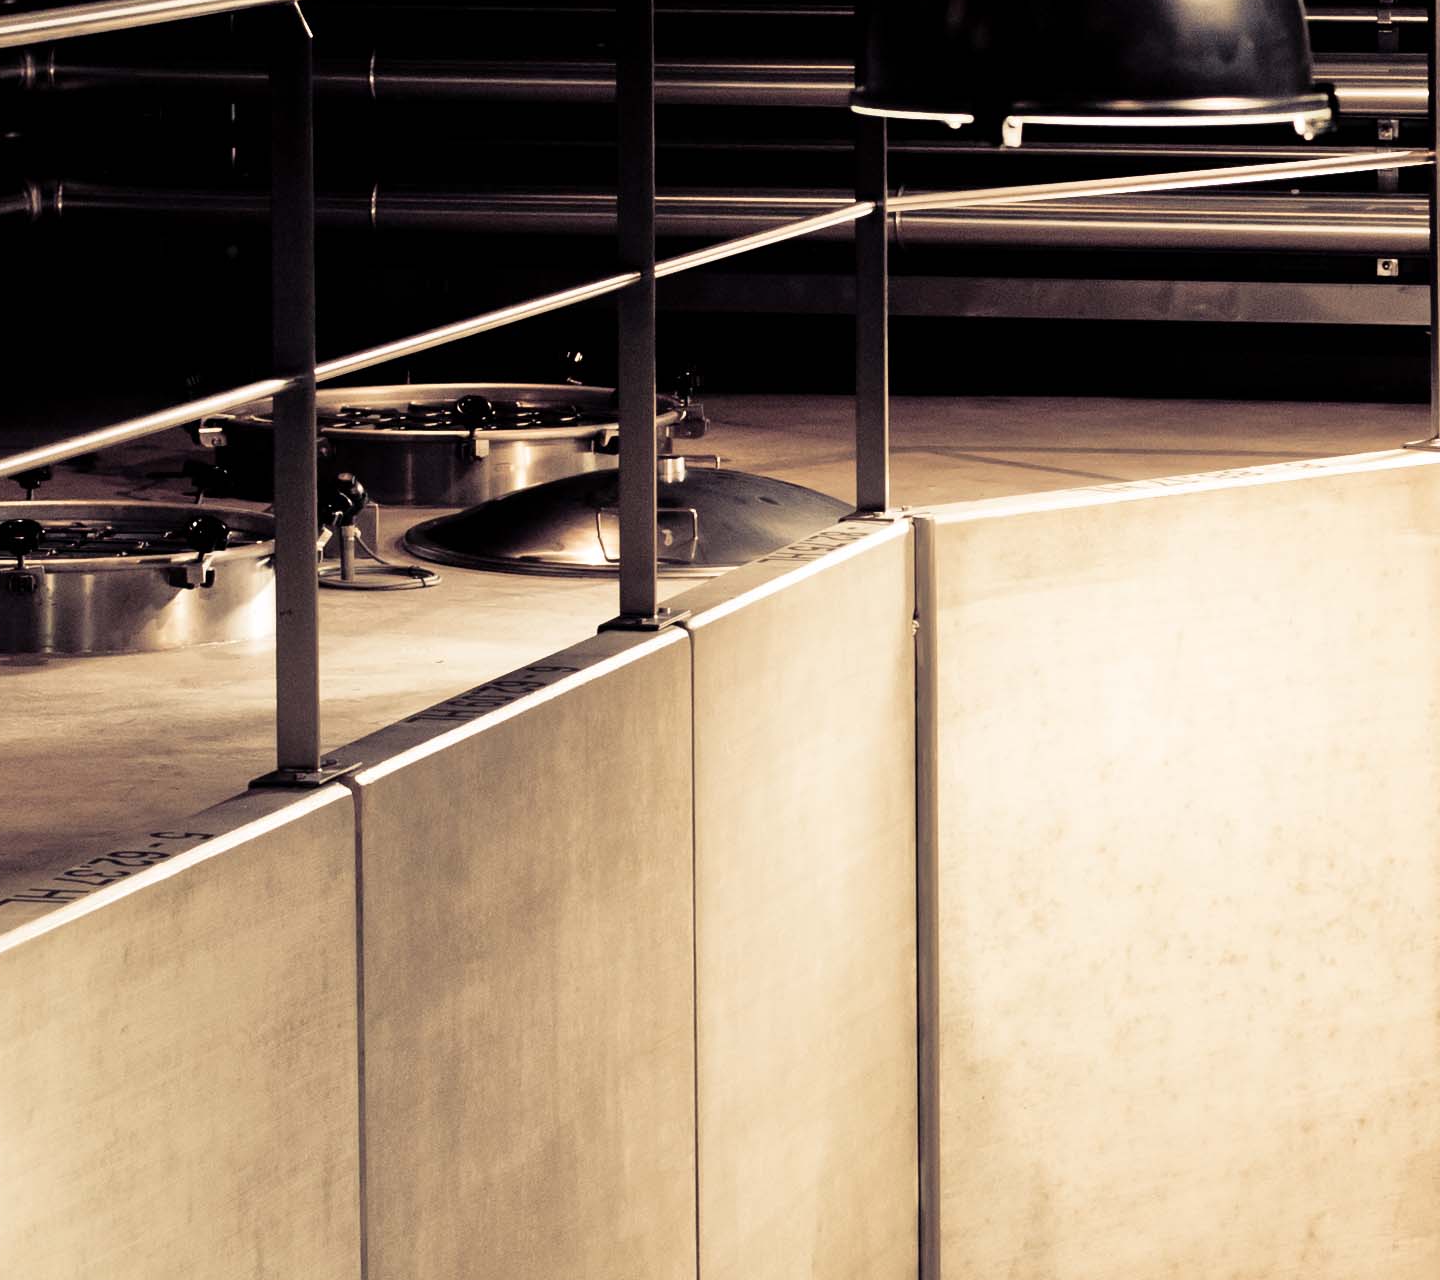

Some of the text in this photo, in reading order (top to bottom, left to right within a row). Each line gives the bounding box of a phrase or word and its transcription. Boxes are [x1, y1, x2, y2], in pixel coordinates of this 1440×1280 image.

[404, 708, 487, 724] HL
[149, 831, 215, 840] 5
[53, 850, 172, 886] 62.37
